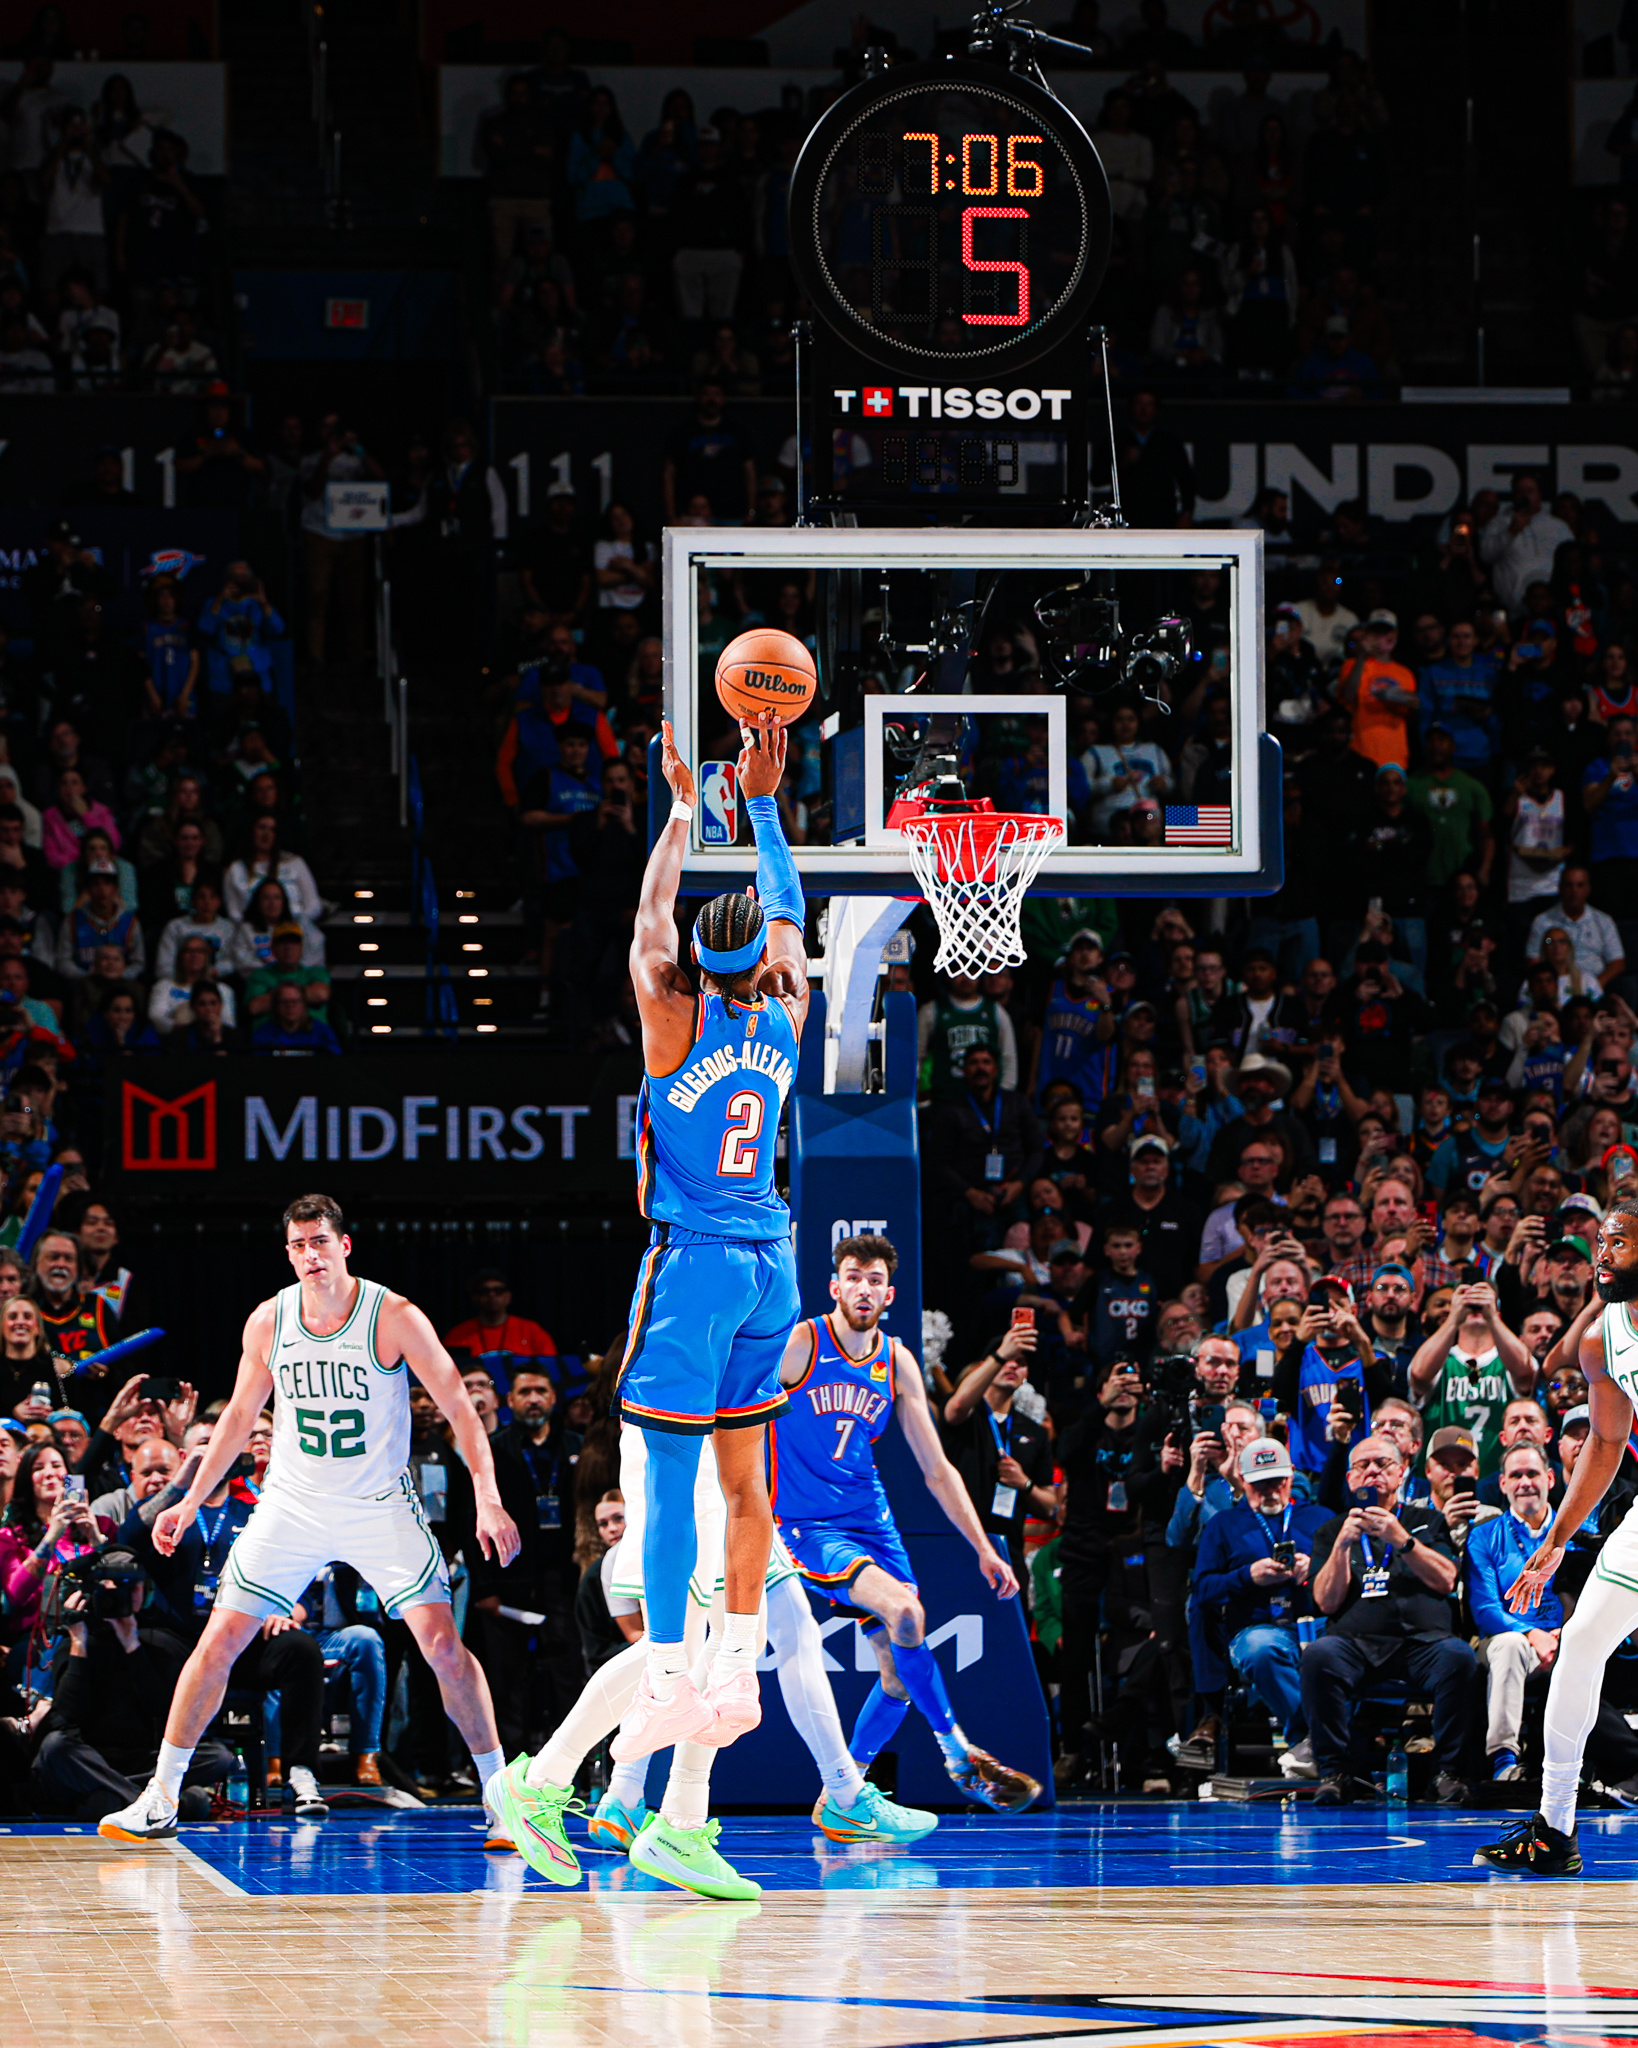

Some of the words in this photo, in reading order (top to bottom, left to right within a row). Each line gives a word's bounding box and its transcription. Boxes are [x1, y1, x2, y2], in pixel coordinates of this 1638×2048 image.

[902, 132, 1044, 197] 7:06
[961, 206, 1031, 327] 5
[898, 386, 1072, 421] TISSOT
[744, 668, 807, 696] Wilson
[705, 825, 723, 839] NBA
[717, 1090, 765, 1177] 2
[1107, 1298, 1150, 1318] OKC
[279, 1360, 370, 1402] CELTICS
[1446, 1375, 1508, 1403] BOSTON
[806, 1382, 889, 1425] THUNDER
[1464, 1405, 1491, 1442] 7
[294, 1407, 367, 1458] 52
[832, 1418, 857, 1461] 7
